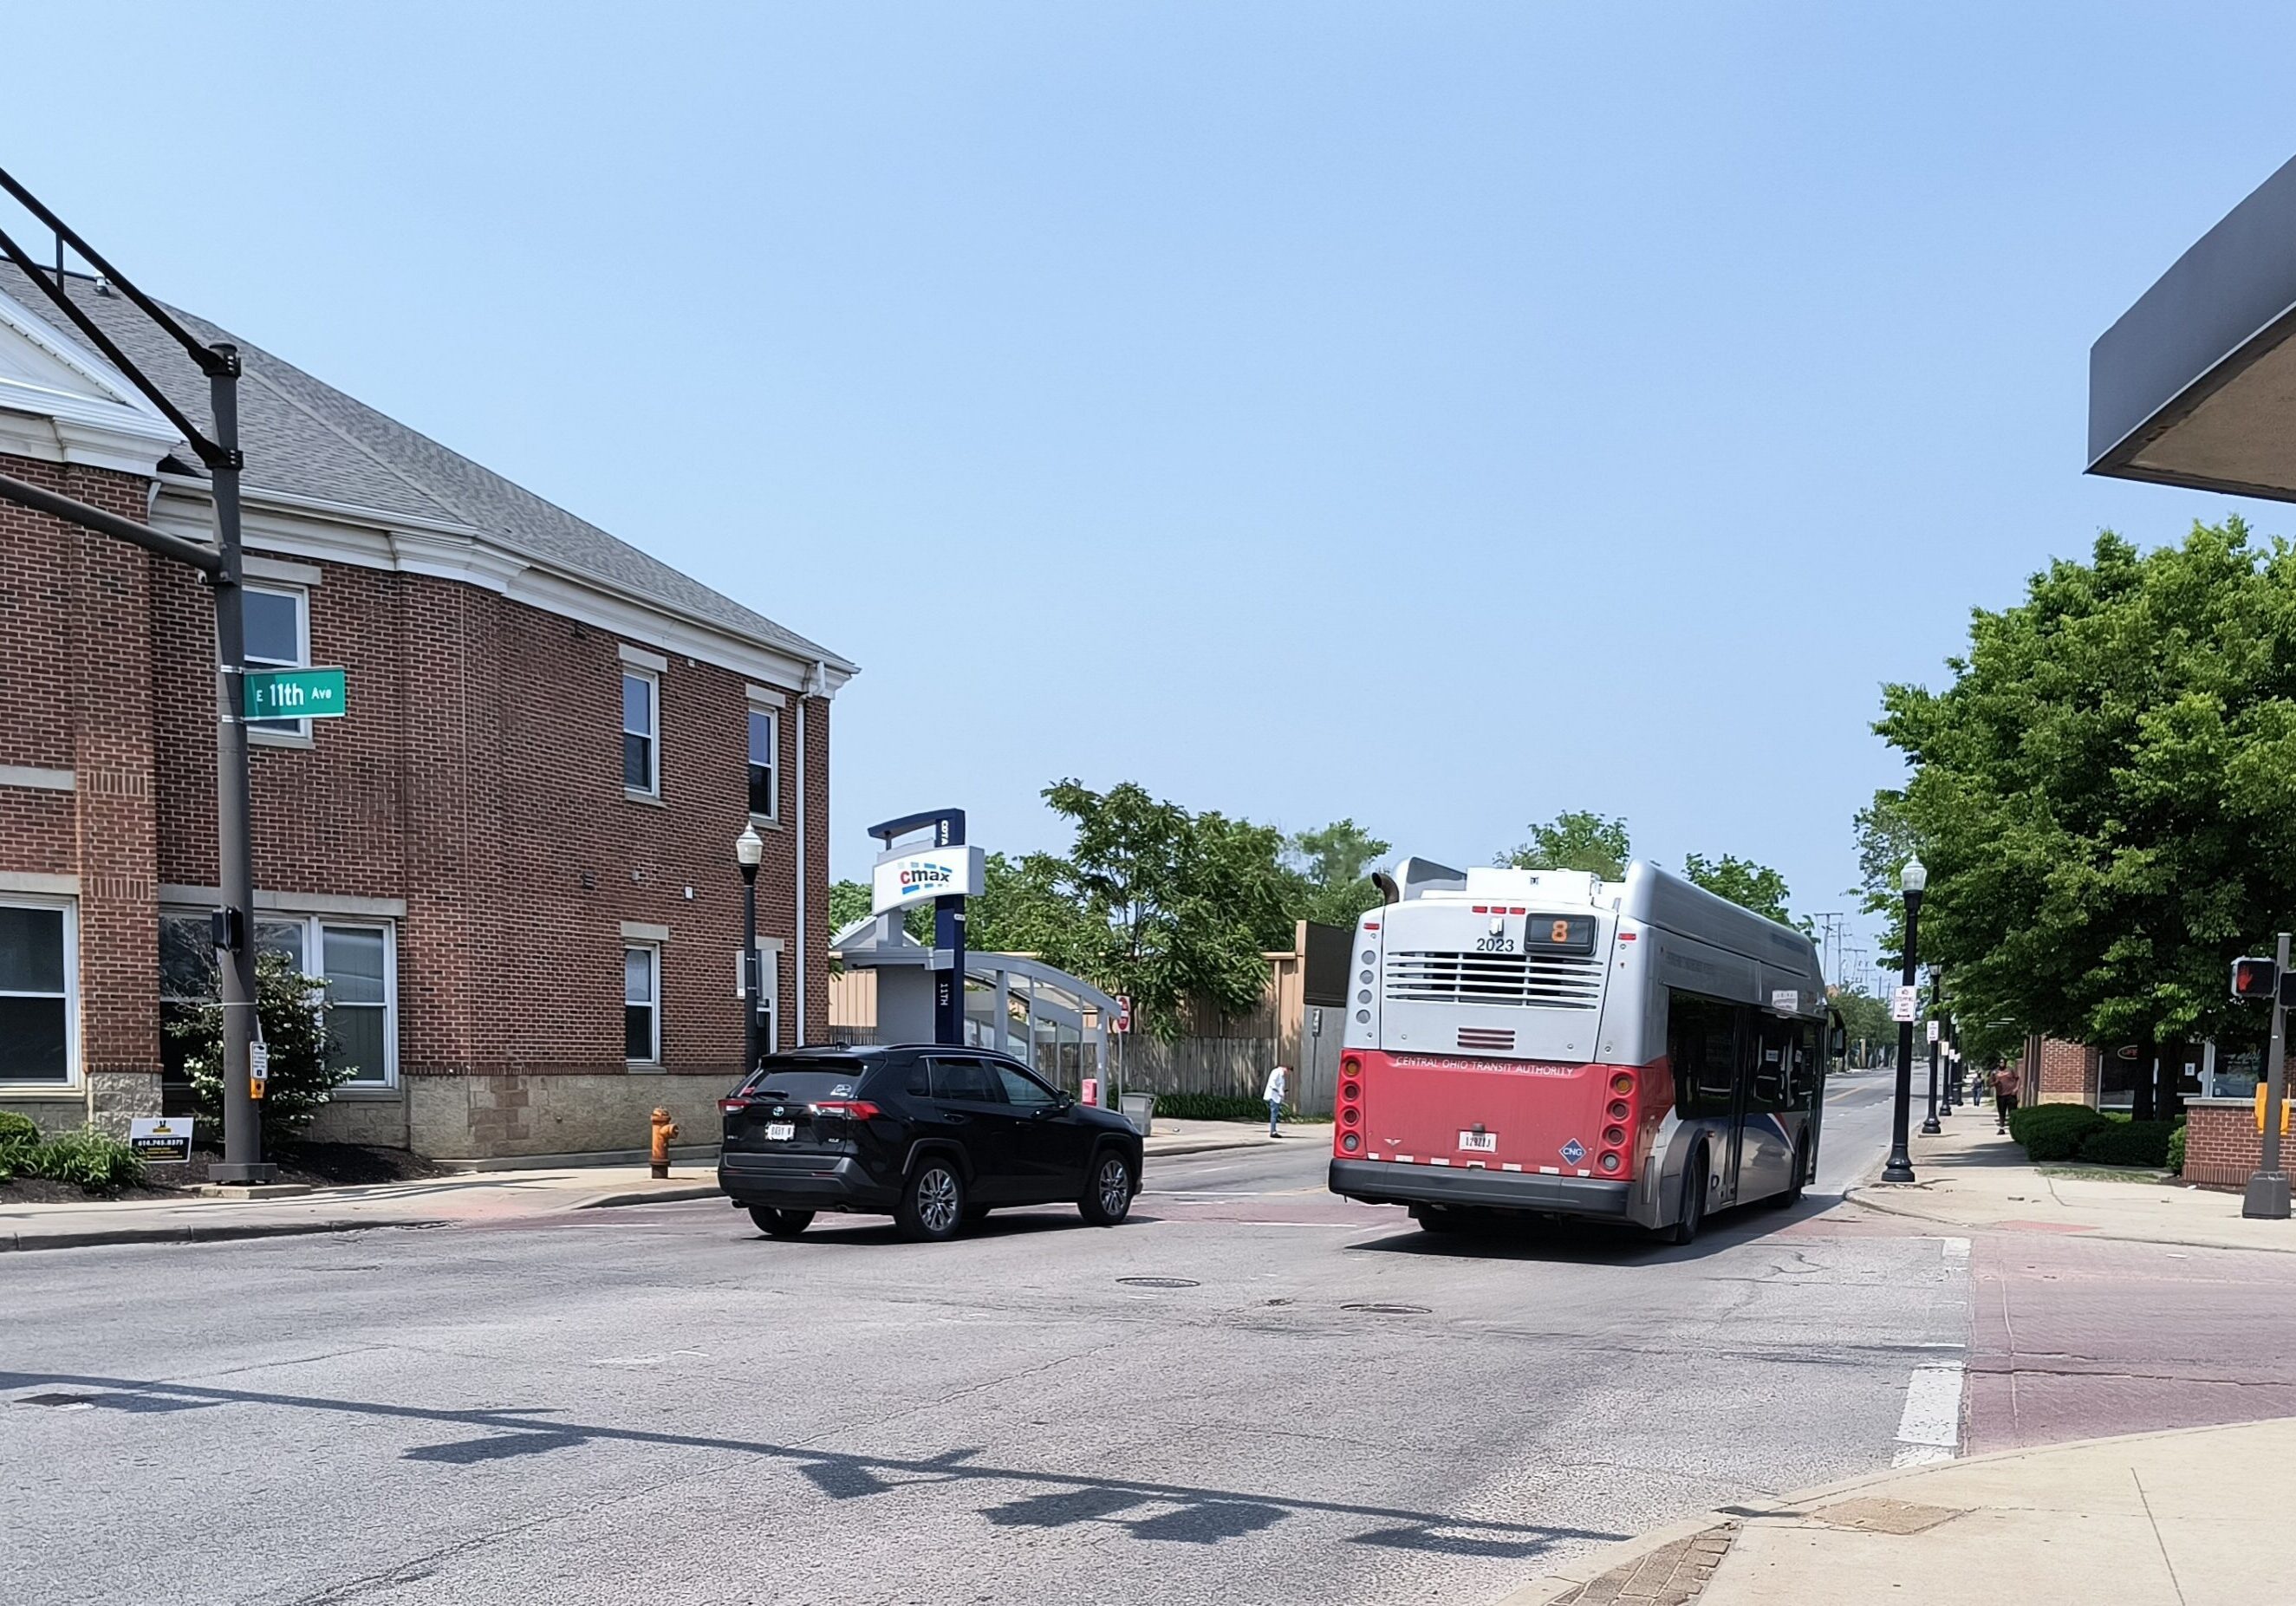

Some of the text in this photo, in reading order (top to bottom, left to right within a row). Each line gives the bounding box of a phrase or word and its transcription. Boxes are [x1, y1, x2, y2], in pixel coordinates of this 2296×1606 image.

[256, 683, 333, 706] E 11th Ave
[900, 869, 951, 885] cmax
[1551, 920, 1569, 943] 8
[1476, 938, 1515, 953] 2023
[940, 983, 949, 1005] 11TH
[1396, 1056, 1574, 1076] CENTRAL OHIO TRANSIT AUTHORITY
[1562, 1148, 1583, 1156] CNG
